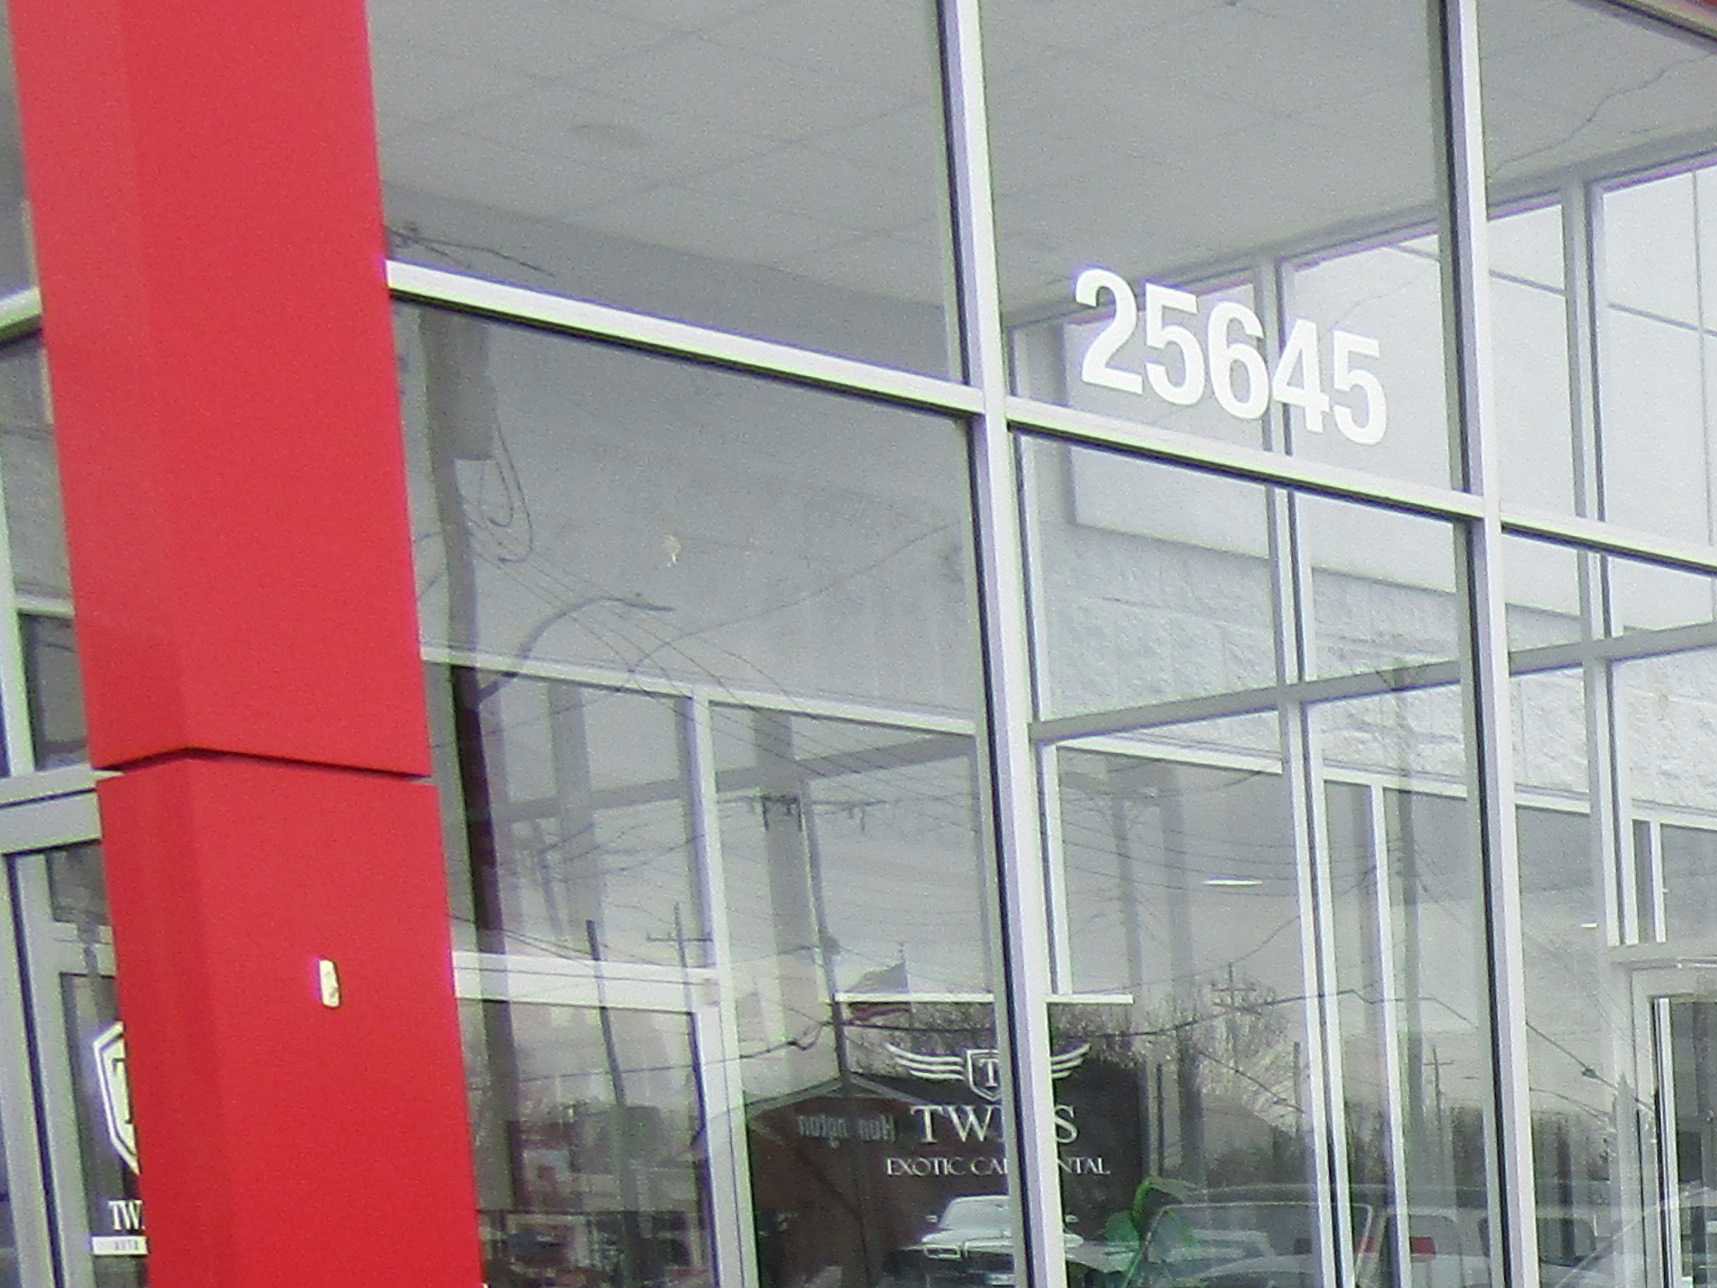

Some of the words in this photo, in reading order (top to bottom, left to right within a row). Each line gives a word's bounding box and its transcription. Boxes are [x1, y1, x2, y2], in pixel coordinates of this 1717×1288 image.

[1075, 268, 1387, 446] 25645
[911, 1105, 1077, 1144] TWS
[886, 1157, 963, 1175] EXOTIC
[1057, 1157, 1111, 1174] NTAL
[108, 1200, 145, 1230] TW
